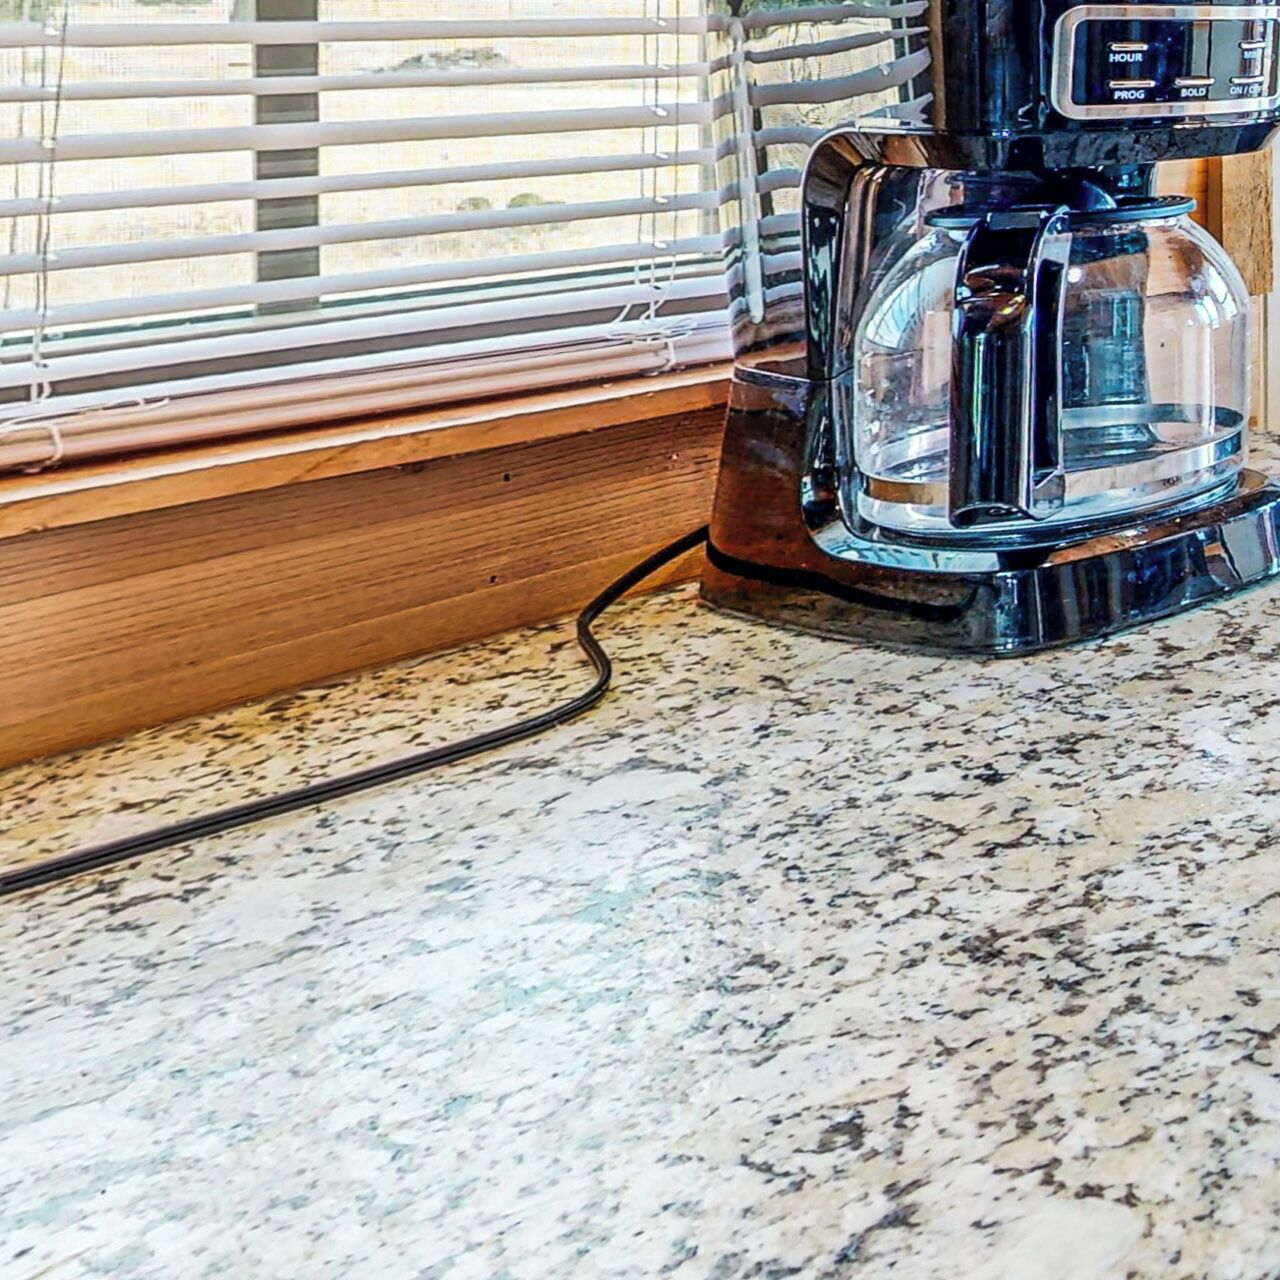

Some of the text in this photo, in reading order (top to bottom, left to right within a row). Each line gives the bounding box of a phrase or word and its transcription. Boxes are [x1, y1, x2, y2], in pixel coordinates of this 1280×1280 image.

[1108, 52, 1144, 63] HOUR
[1113, 90, 1146, 100] PROG
[1180, 87, 1207, 97] BOLD
